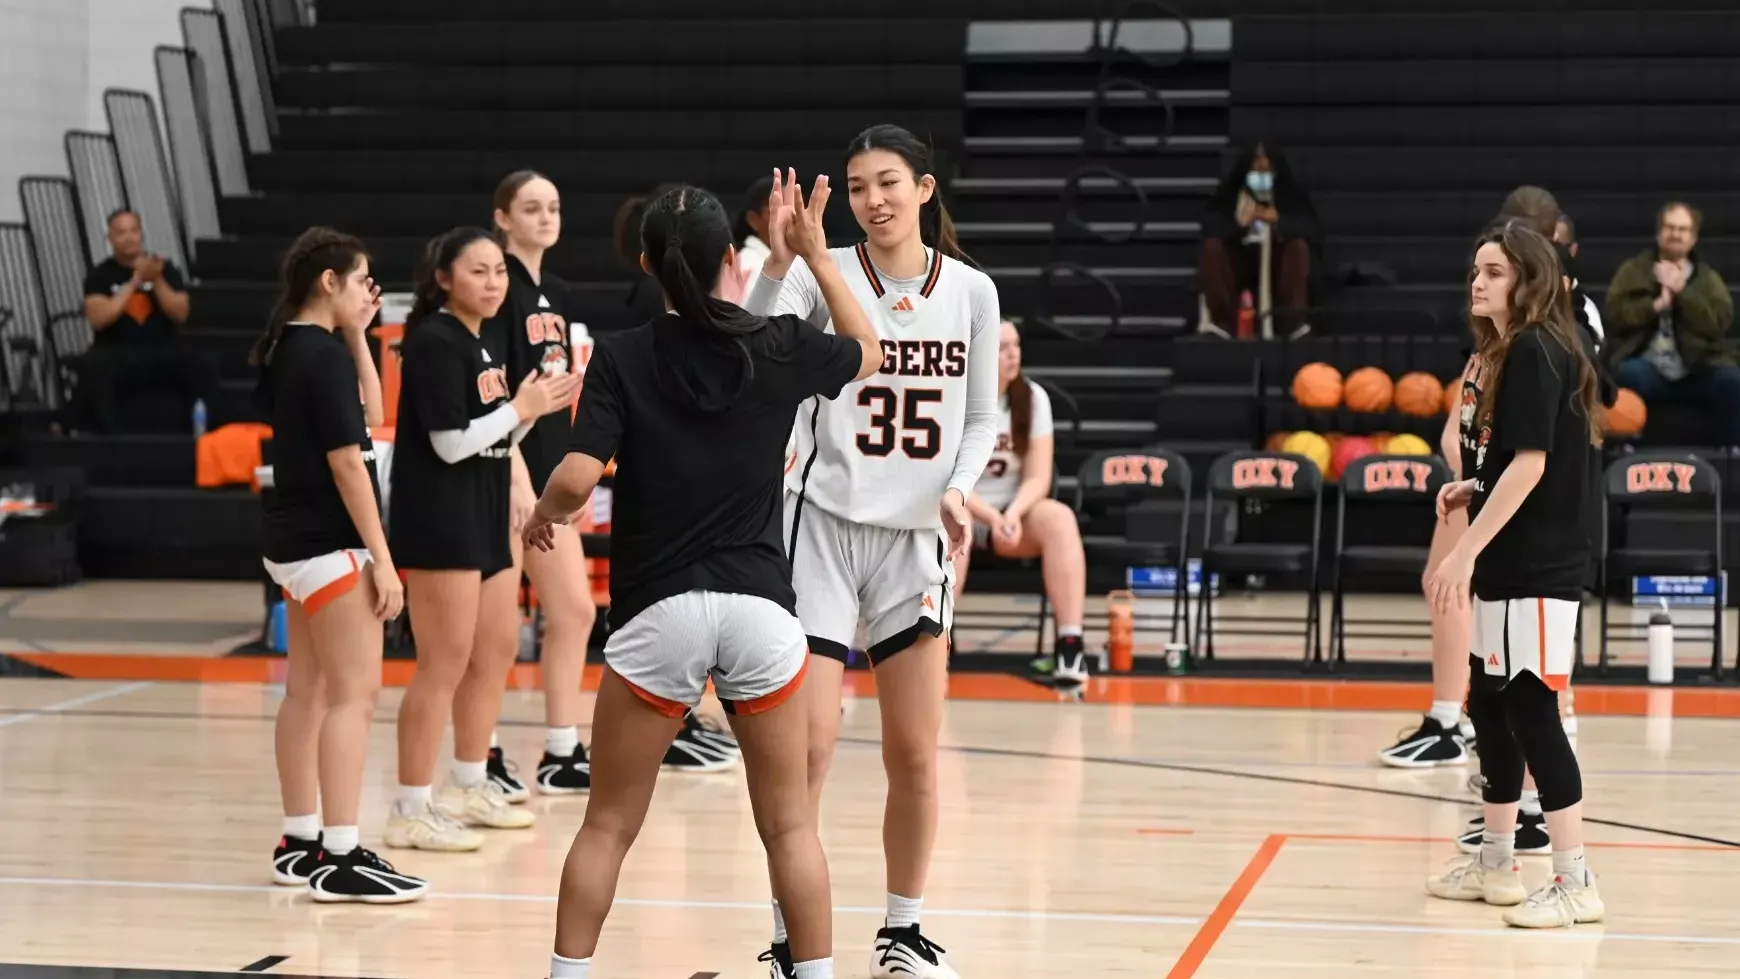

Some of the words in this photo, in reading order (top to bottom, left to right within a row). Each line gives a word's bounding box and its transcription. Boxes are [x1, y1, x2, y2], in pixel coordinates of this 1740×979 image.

[878, 339, 967, 378] GERS
[855, 385, 943, 460] 35
[1102, 455, 1168, 487] OXY
[1232, 457, 1299, 490] OXY
[1364, 460, 1432, 492] OXY
[1627, 462, 1696, 493] OXY
